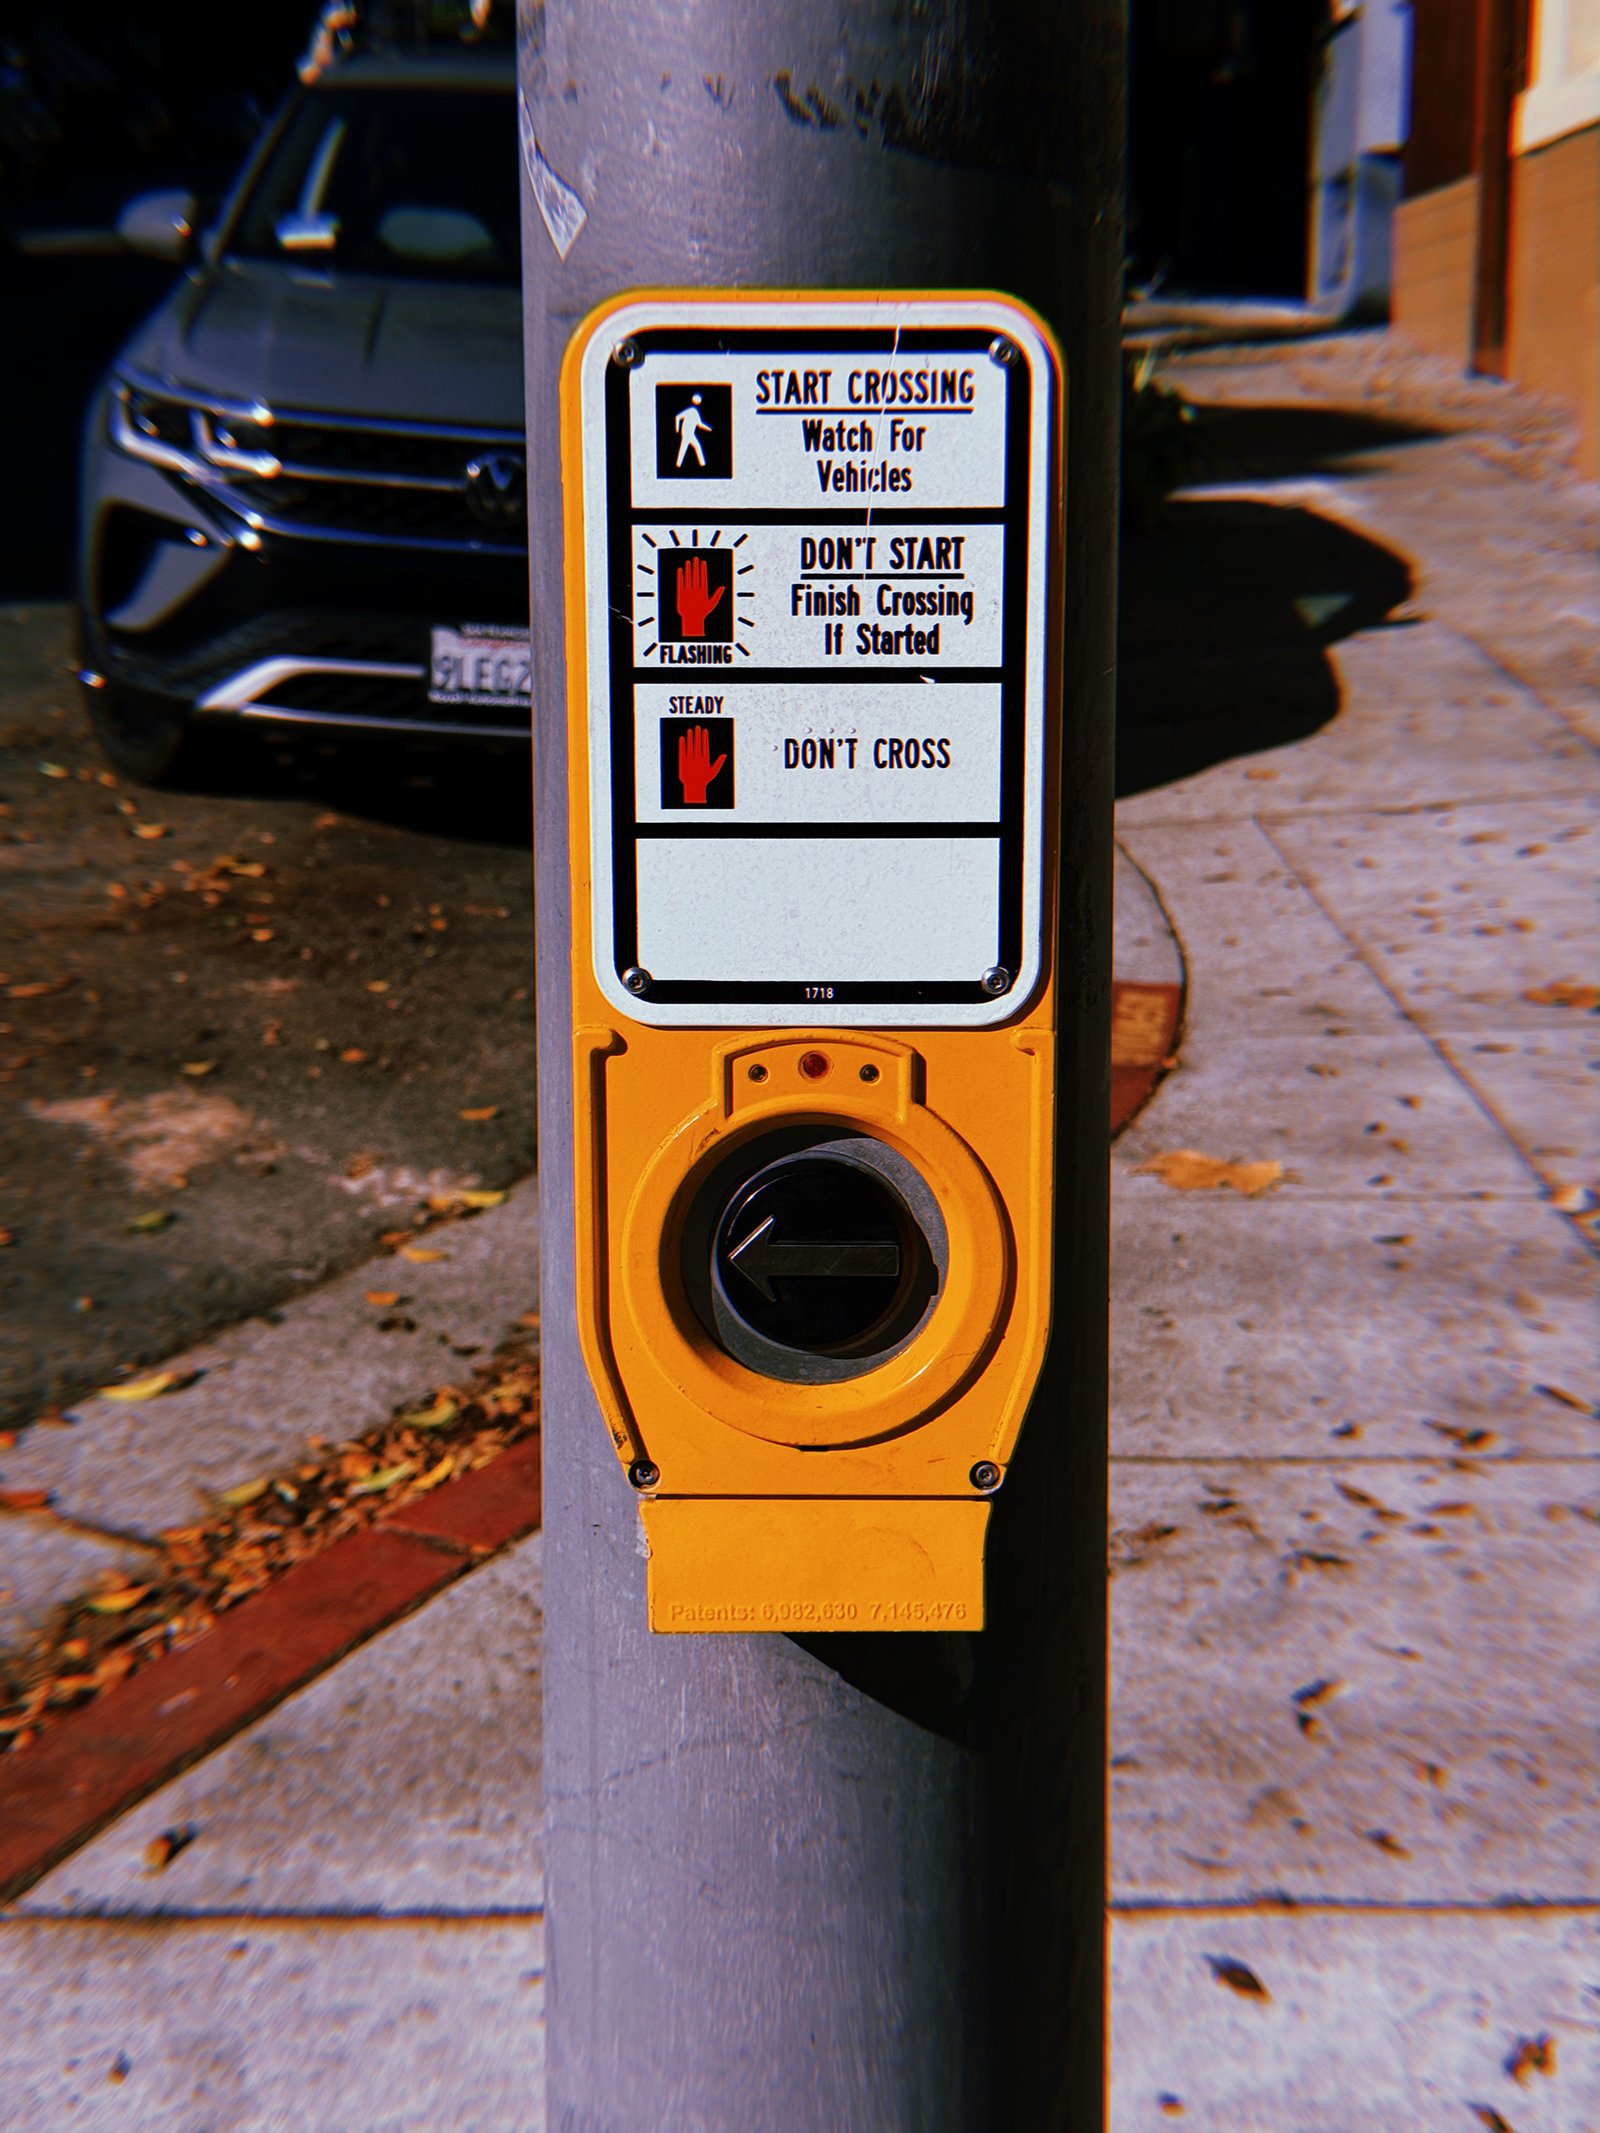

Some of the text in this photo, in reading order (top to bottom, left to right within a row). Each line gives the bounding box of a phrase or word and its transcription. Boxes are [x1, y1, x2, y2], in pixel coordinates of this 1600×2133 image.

[755, 370, 975, 405] START CROSSING
[801, 418, 926, 453] Watch For
[816, 459, 912, 493] Vehicles
[800, 536, 965, 571] DON'T START
[791, 583, 974, 626] Finish Crossing
[659, 644, 733, 665] FLASHING
[824, 622, 940, 656] If Started
[668, 695, 724, 715] STEADY
[784, 737, 951, 770] DON'T CROSS
[804, 986, 834, 999] 1718
[670, 1601, 967, 1622] Patents: 6,982,630 7,145,476
